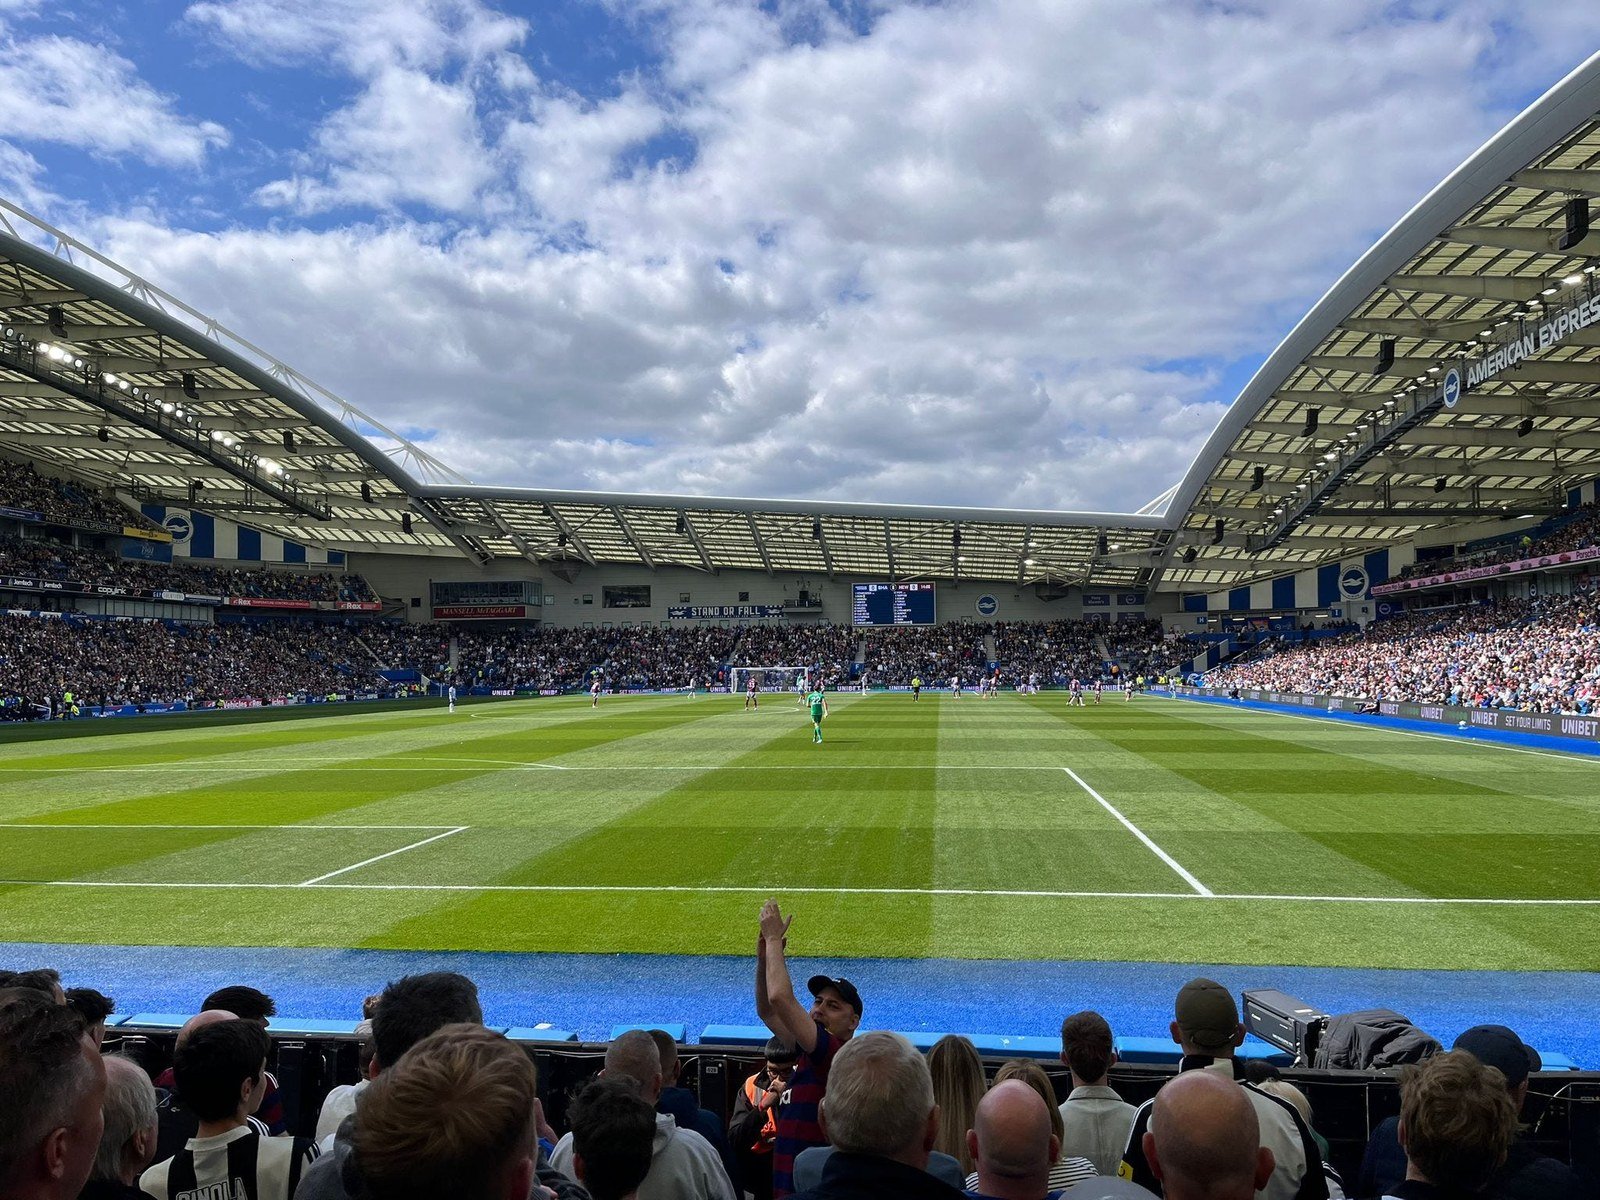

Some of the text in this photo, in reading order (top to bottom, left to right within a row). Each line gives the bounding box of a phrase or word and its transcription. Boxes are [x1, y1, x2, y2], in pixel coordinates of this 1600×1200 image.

[1466, 332, 1535, 389] AMERICAN
[69, 518, 88, 528] DENTAL
[1576, 549, 1597, 559] Porsche
[238, 598, 251, 606] Rex
[346, 602, 362, 610] Rex
[442, 607, 475, 615] MANSELL
[691, 606, 760, 616] STAND OR FALL
[1420, 707, 1443, 720] UNIBET
[1470, 711, 1498, 726] UNIBET
[1505, 715, 1551, 731] SET YOUR LIMITS
[1561, 718, 1598, 737] UNIBET
